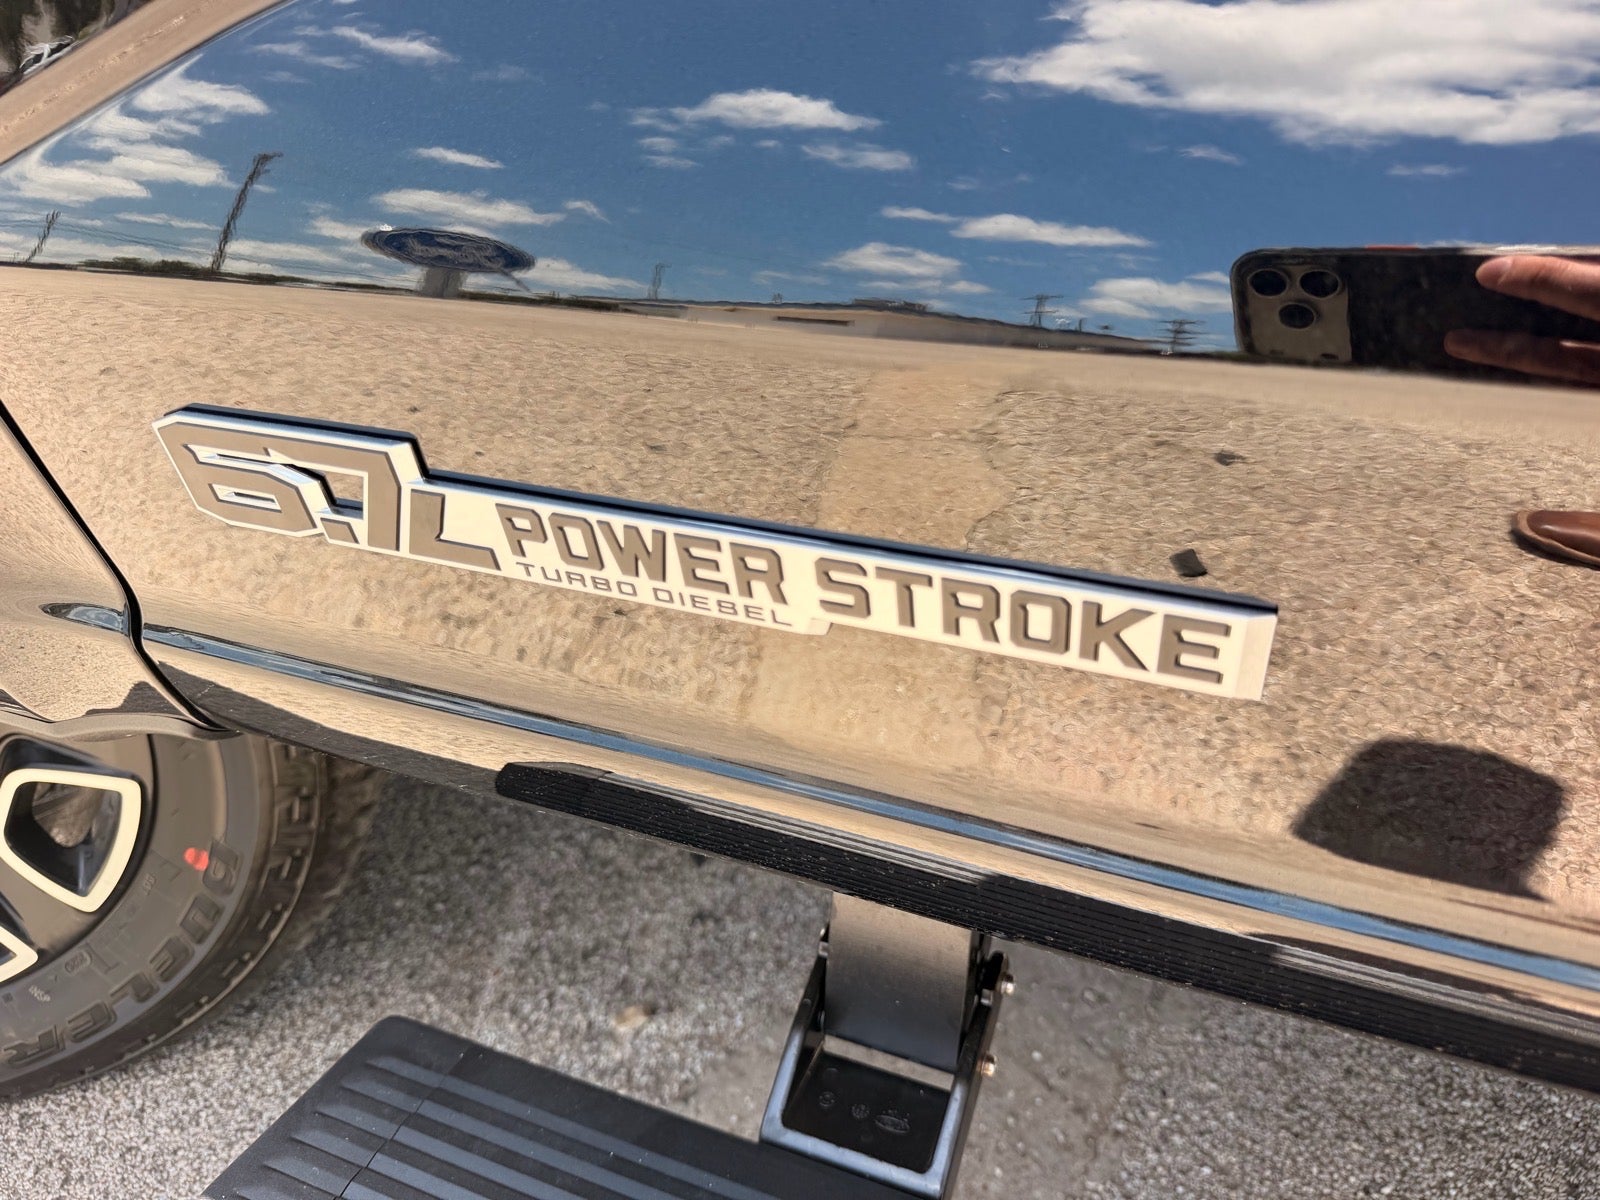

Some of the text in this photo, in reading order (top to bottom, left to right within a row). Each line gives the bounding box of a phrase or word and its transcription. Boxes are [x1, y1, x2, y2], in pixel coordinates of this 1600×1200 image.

[495, 502, 789, 606] POWER
[814, 556, 1233, 686] STROKE
[515, 561, 793, 627] TURBO DIESEL
